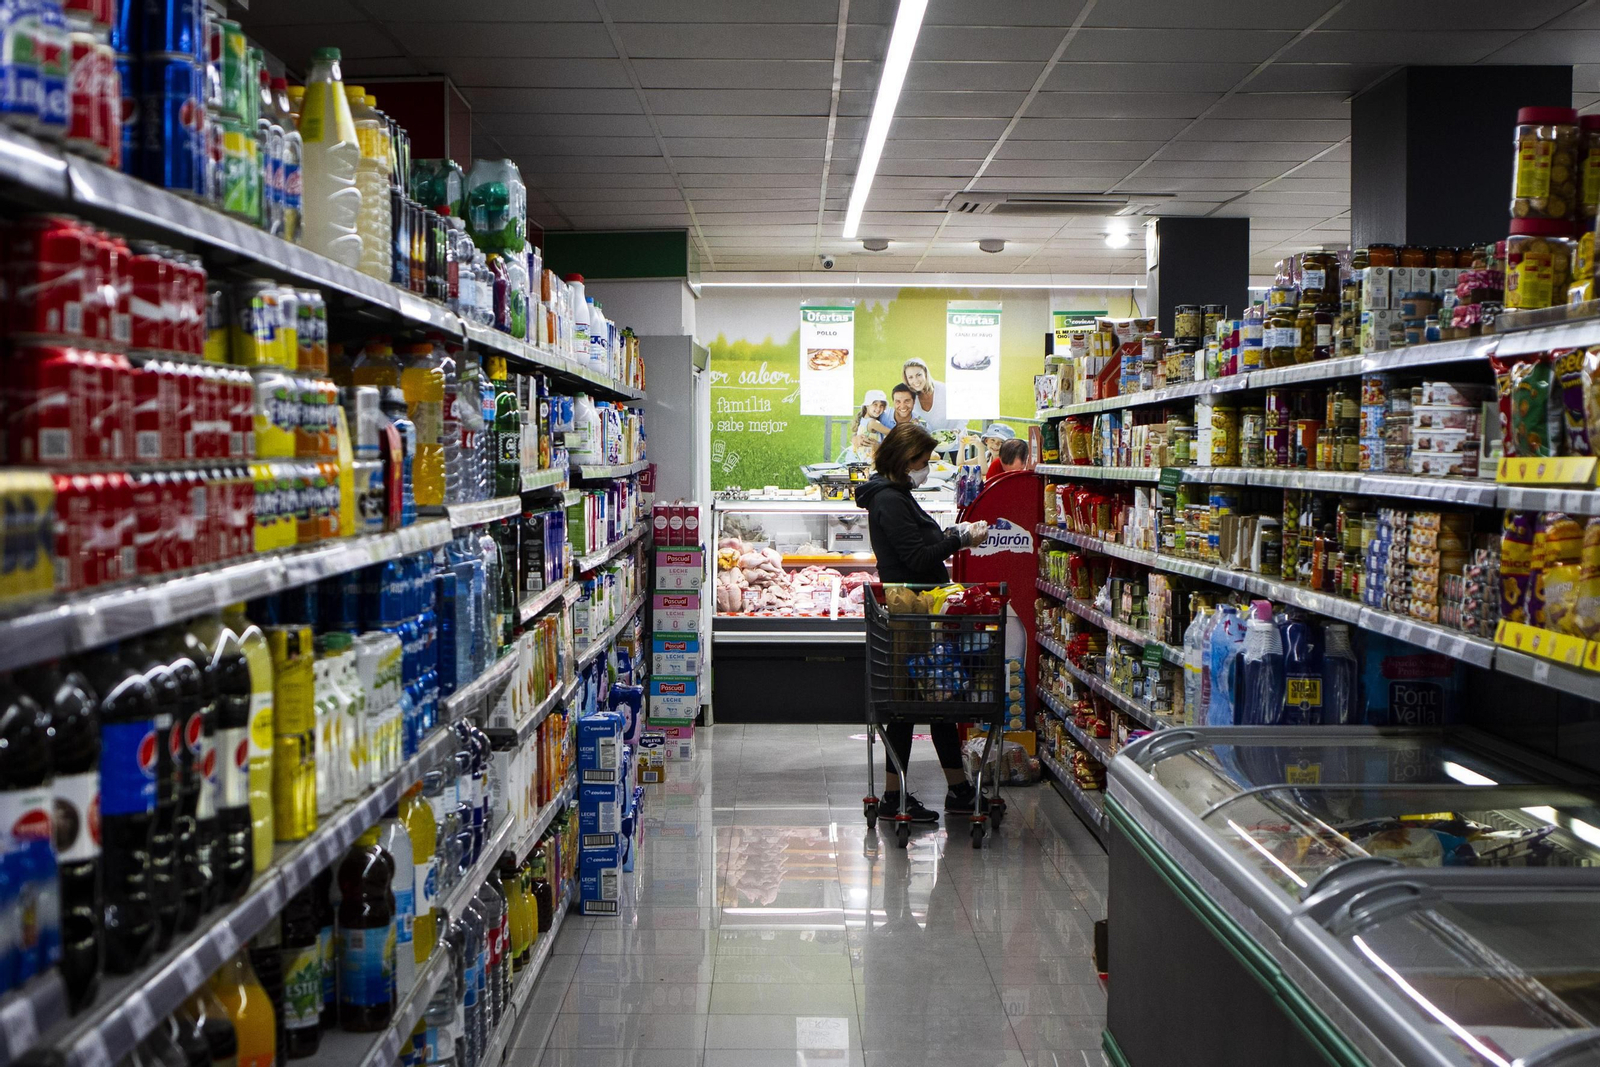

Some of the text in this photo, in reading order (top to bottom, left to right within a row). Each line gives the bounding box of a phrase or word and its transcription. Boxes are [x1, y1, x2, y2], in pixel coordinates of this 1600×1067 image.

[807, 312, 849, 321] Ofertas
[952, 315, 995, 325] Ofertas
[717, 396, 772, 414] familia
[717, 416, 788, 435] sabe mejor
[1393, 685, 1436, 705] Font
[1393, 704, 1437, 725] Vella
